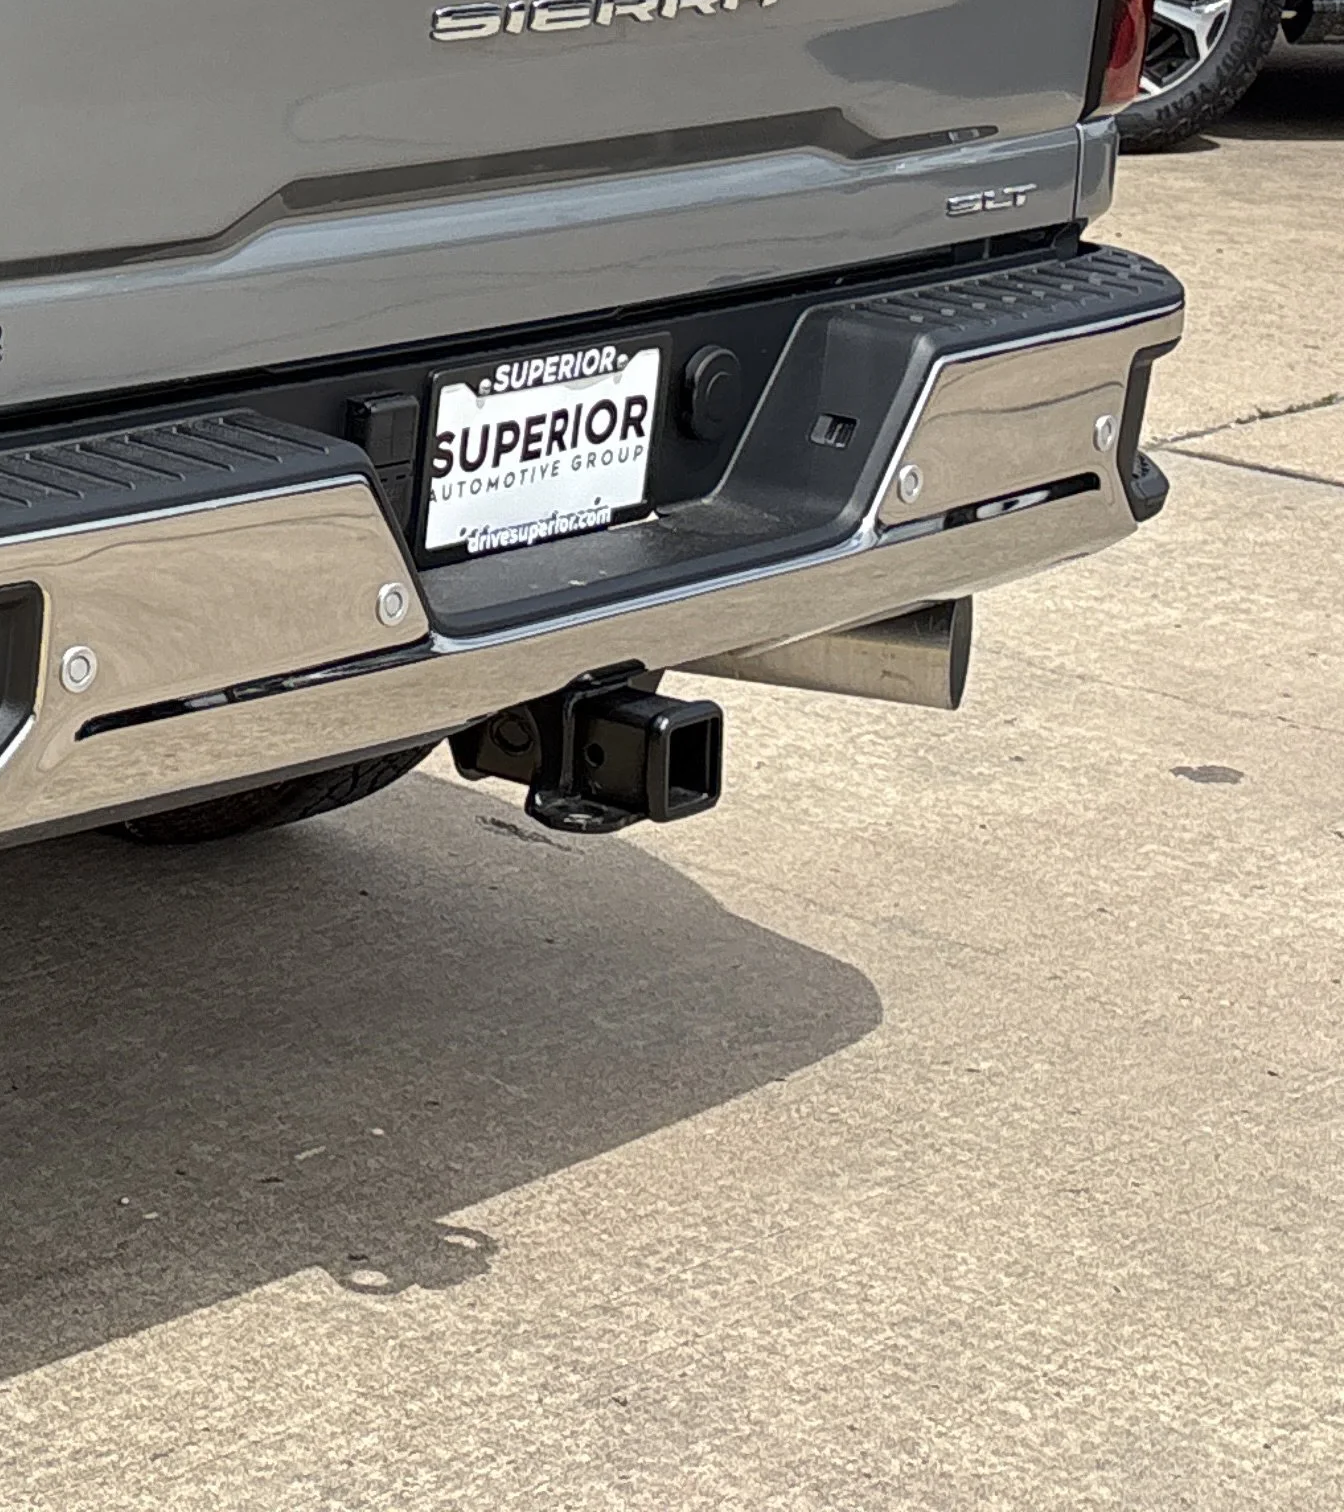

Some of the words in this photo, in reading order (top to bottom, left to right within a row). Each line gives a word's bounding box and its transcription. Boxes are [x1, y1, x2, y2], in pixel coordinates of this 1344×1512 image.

[946, 183, 1037, 217] SLT
[493, 345, 617, 392] SUPERIOR
[432, 394, 648, 479] SUPERIOR
[429, 459, 561, 503] AUTOMOTIVE
[571, 445, 644, 472] GROUP
[466, 506, 612, 554] drivesuperior.com
